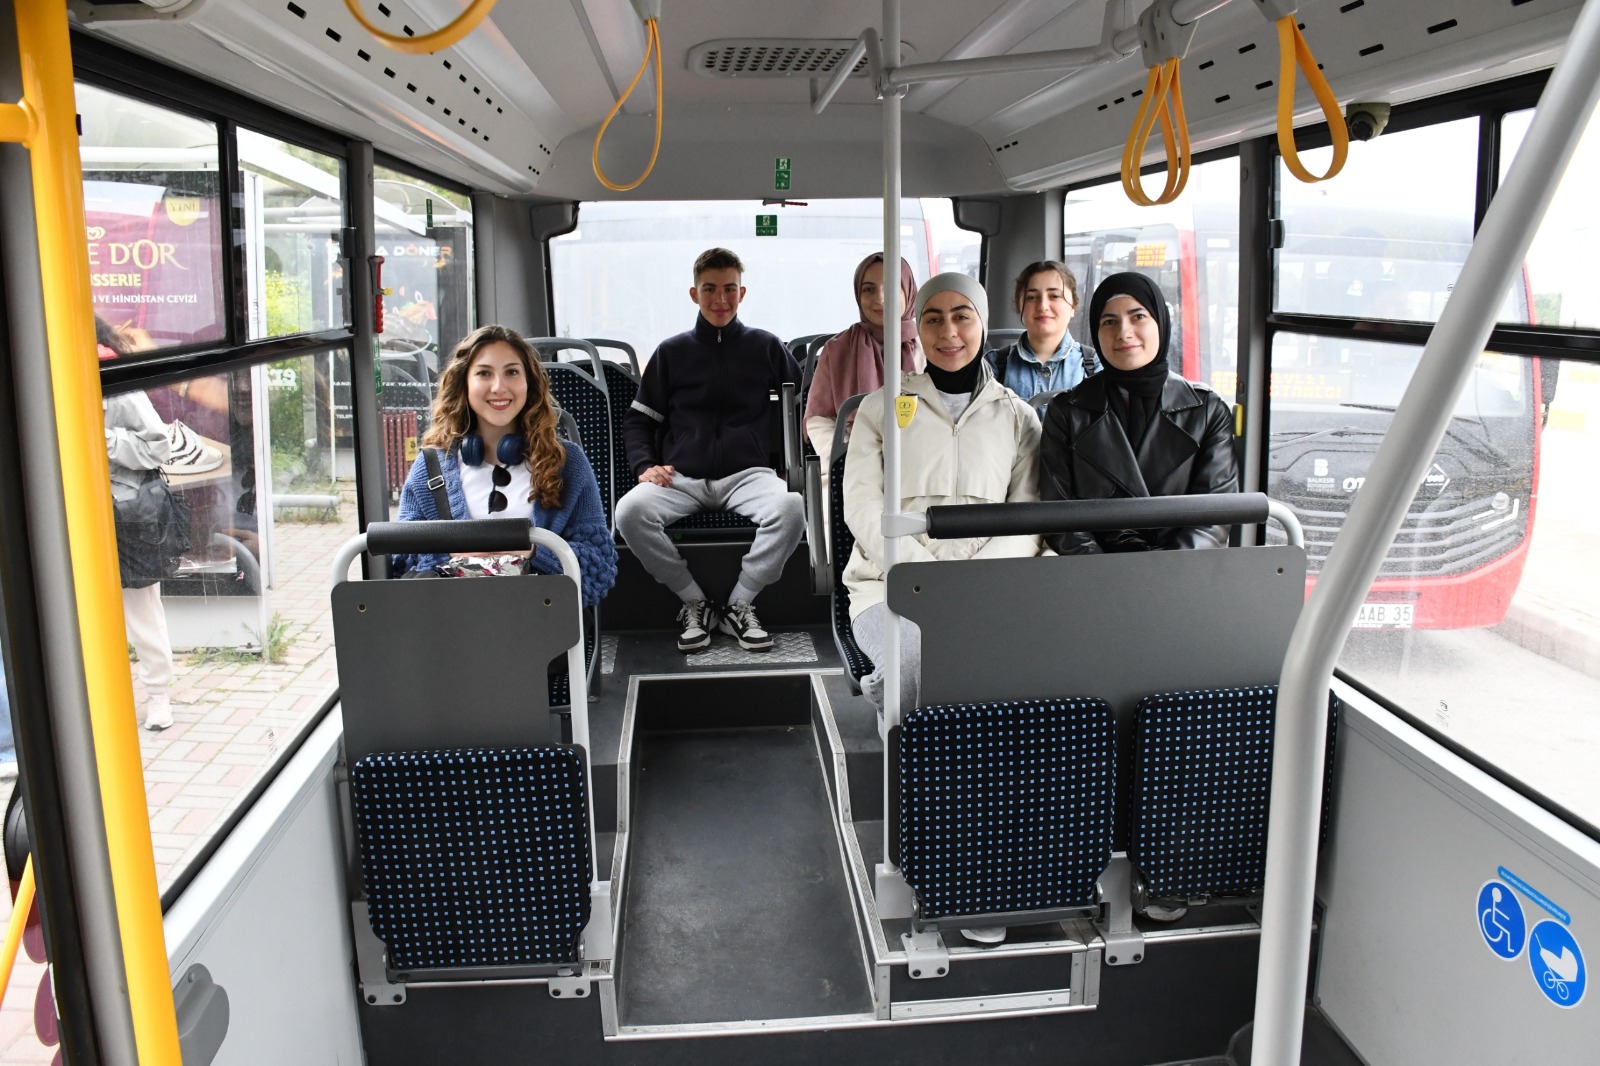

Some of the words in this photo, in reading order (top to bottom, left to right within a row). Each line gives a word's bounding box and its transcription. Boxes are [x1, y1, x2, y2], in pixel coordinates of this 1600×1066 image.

[108, 239, 190, 270] D'OR
[90, 273, 142, 287] ISSERIE
[98, 294, 111, 304] VE
[1393, 606, 1411, 622] 35
